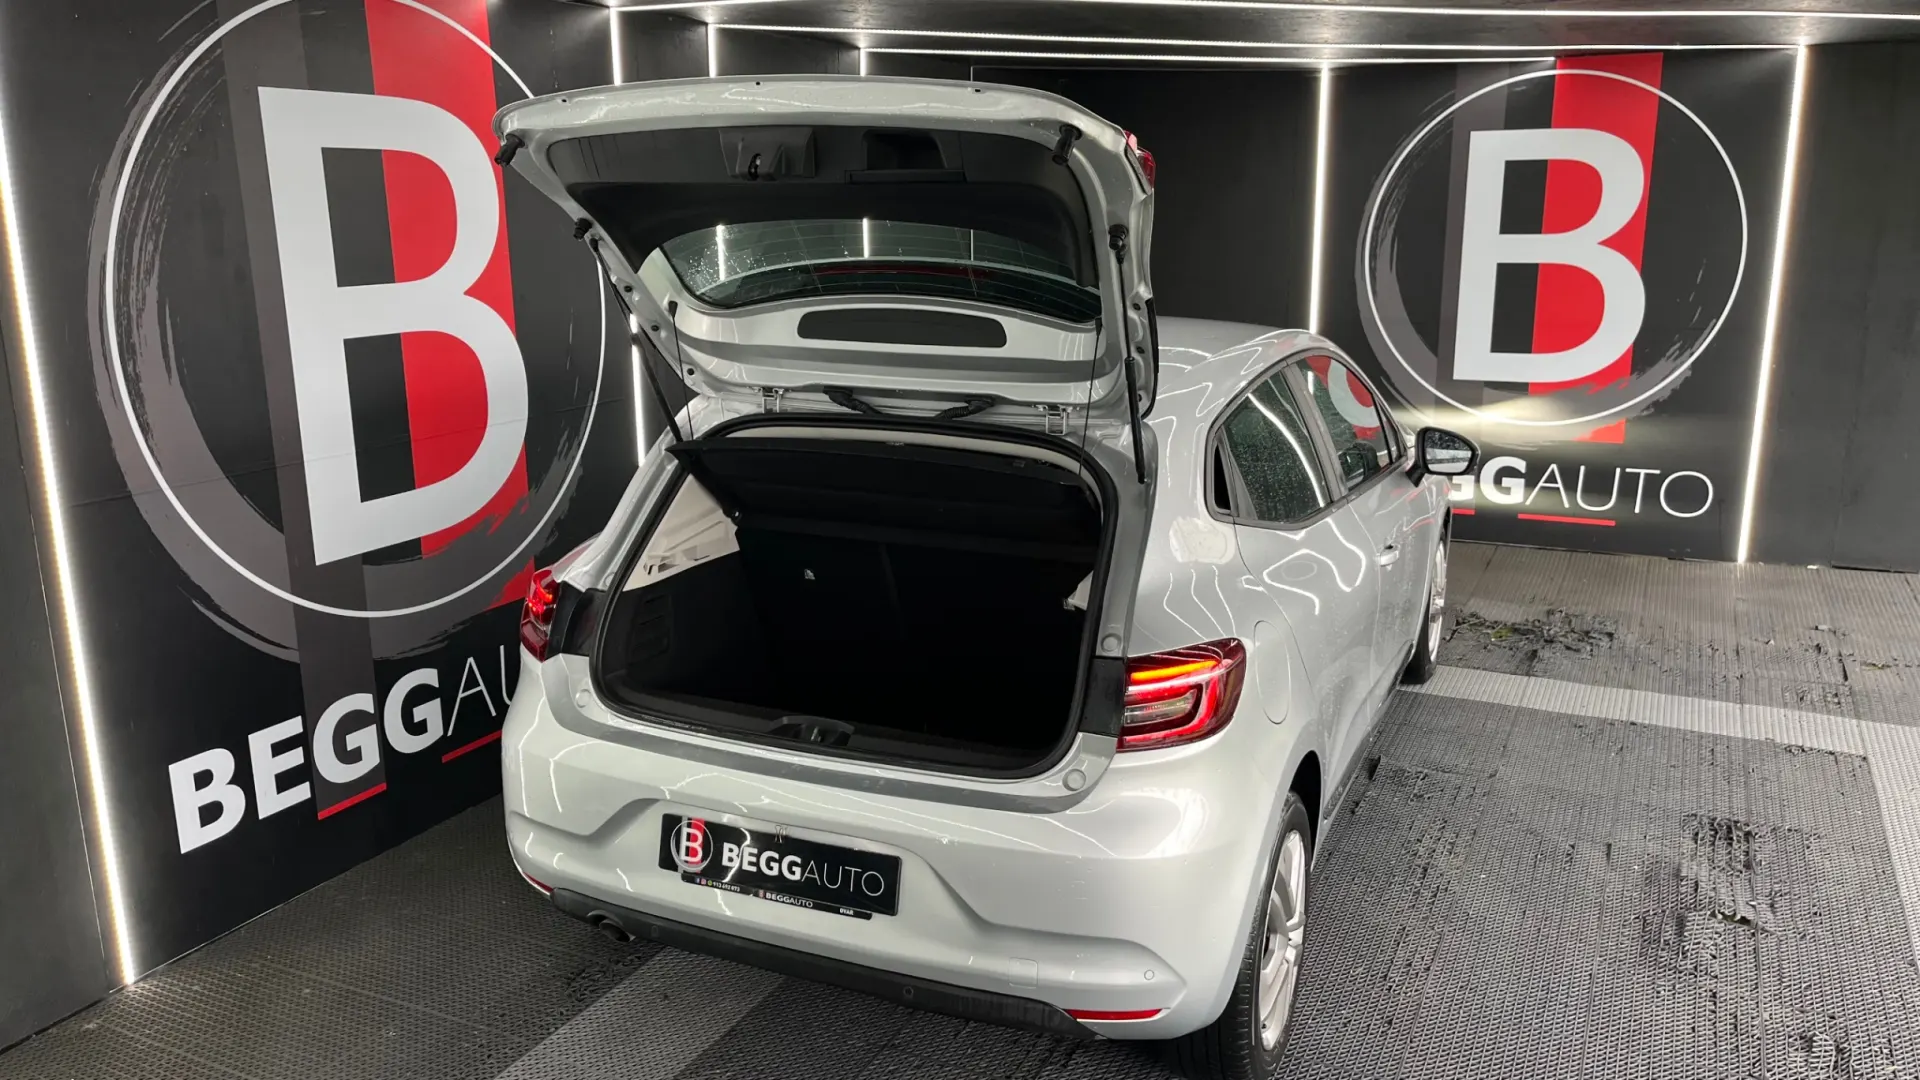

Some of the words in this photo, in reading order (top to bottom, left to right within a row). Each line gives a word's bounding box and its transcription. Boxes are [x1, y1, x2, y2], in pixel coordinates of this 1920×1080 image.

[1453, 128, 1645, 382] B
[258, 86, 529, 566] B
[680, 827, 703, 863] B
[721, 842, 885, 897] BEGGAUTO
[765, 891, 814, 908] BEGGAUTO
